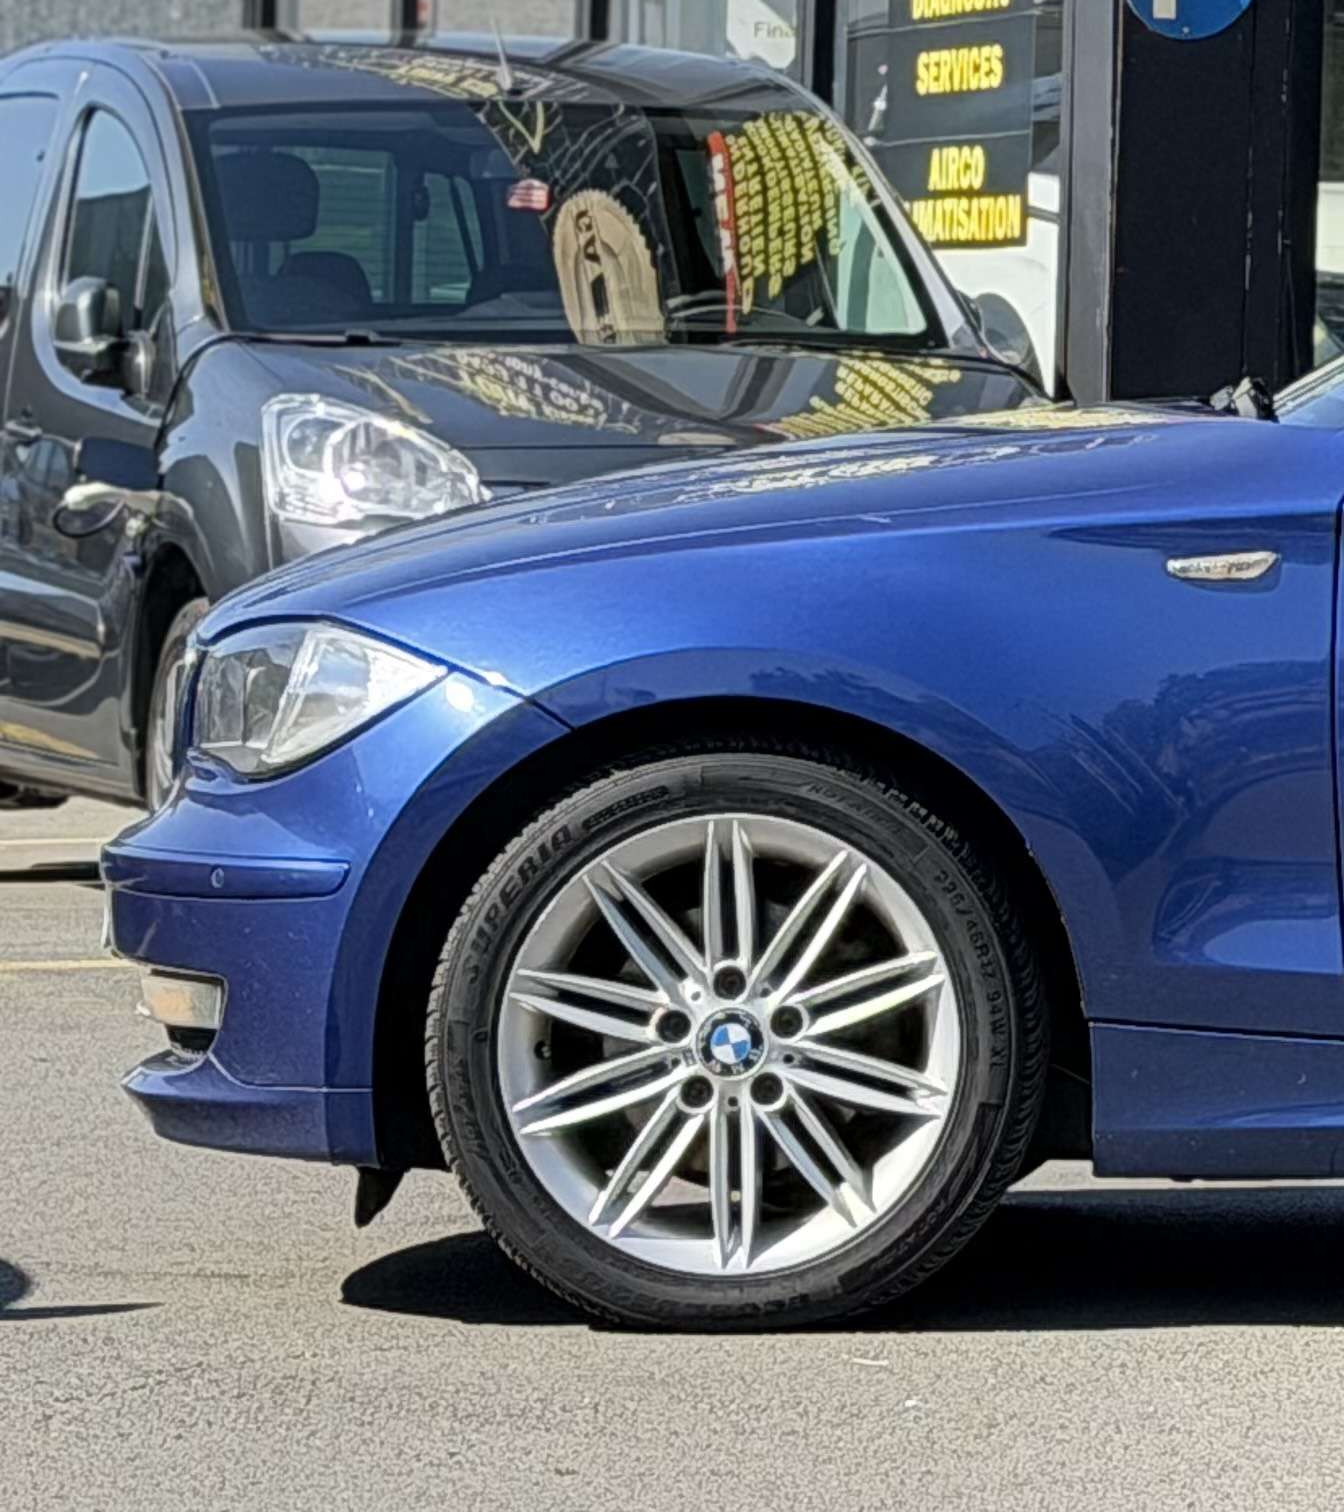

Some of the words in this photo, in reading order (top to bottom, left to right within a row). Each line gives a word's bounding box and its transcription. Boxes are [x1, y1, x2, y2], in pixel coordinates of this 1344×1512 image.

[915, 44, 1004, 97] SERVICES
[927, 144, 986, 191] AIRCO
[463, 823, 573, 985] SUPERIA
